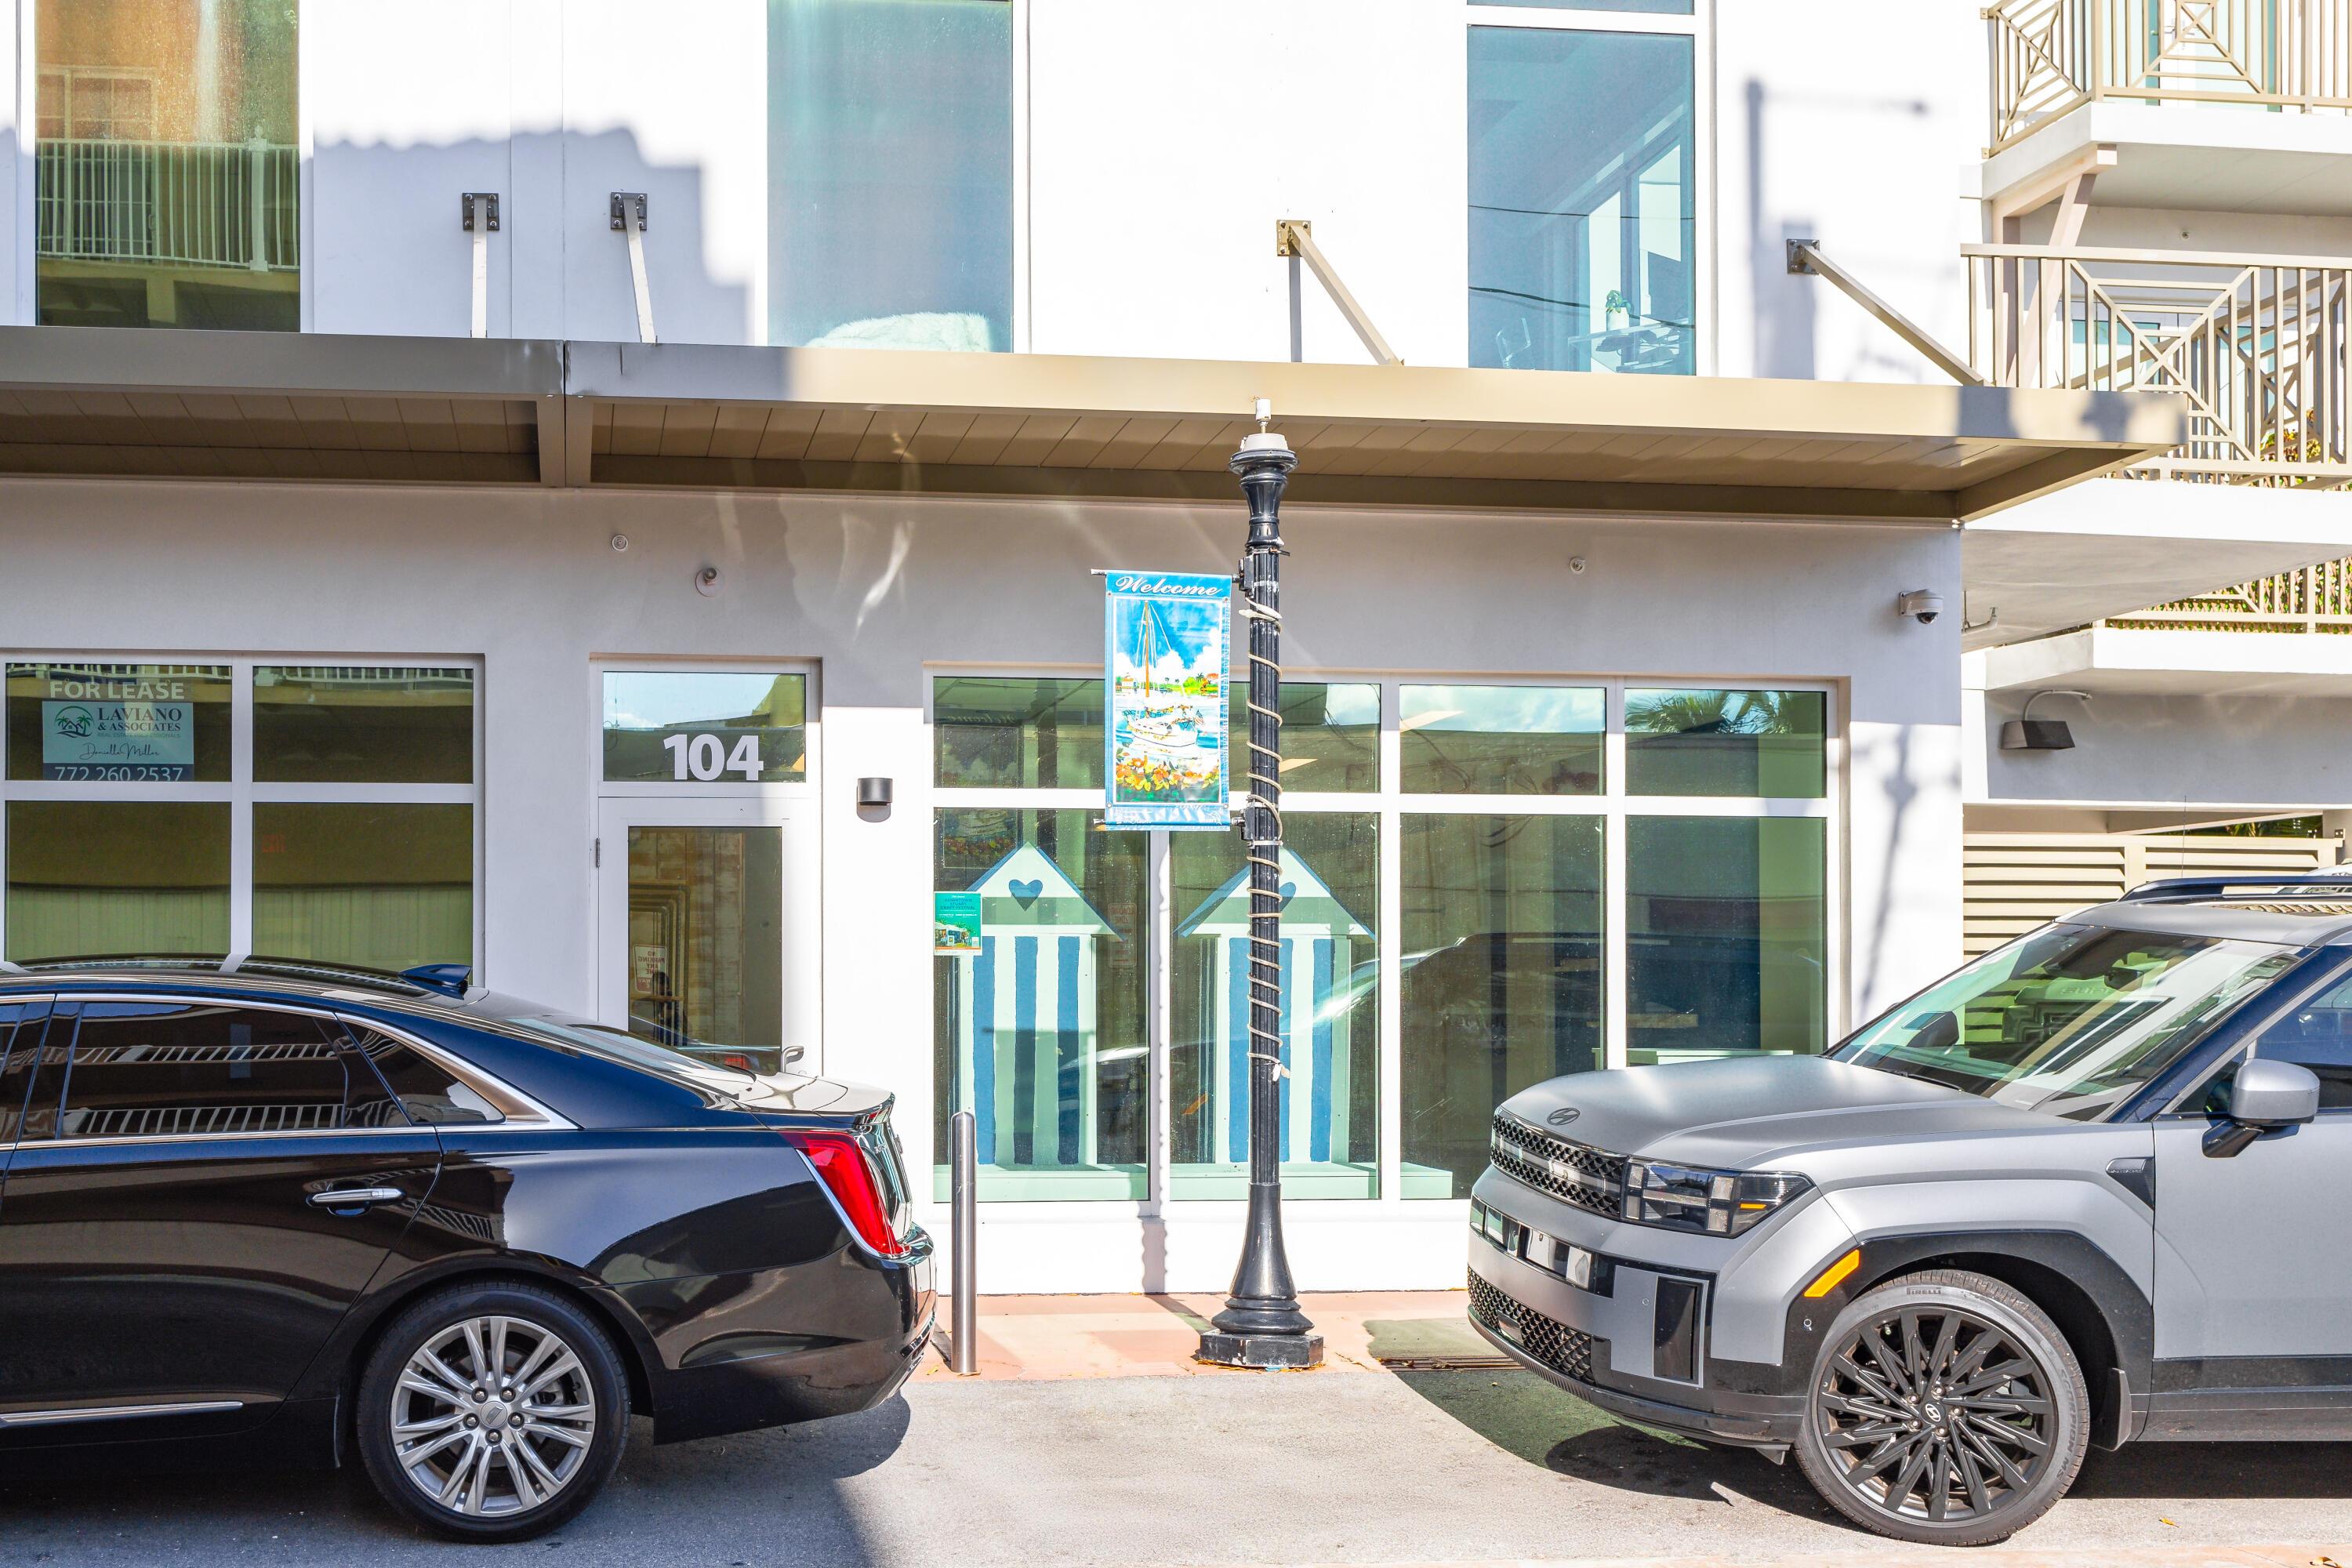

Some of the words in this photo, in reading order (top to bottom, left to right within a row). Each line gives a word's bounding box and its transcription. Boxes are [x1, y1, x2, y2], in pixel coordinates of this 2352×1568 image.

[1114, 575, 1224, 597] Welcome
[49, 681, 101, 699] FOR
[107, 681, 185, 700] LEASE
[97, 707, 183, 722] LAVIANO
[109, 722, 181, 731] ASSOCIATES
[663, 733, 764, 782] 104
[54, 766, 183, 781] 772.260.2537
[1906, 1287, 1942, 1295] PIRELLI
